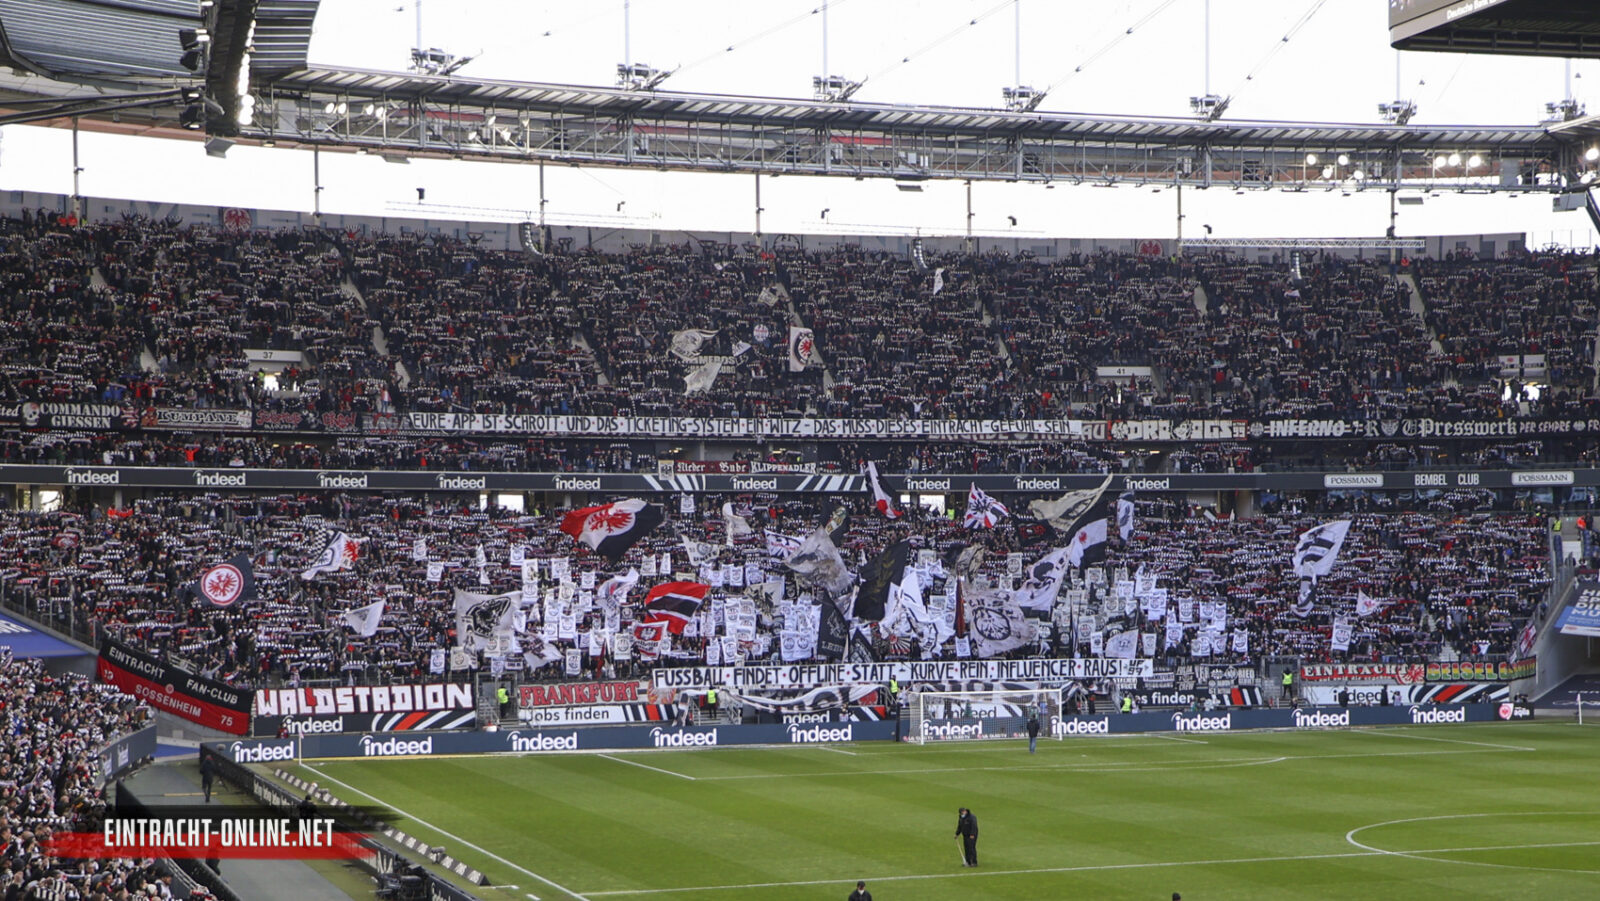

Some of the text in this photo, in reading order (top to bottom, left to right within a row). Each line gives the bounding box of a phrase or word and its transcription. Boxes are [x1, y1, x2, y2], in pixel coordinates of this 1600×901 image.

[263, 351, 273, 359] 37
[1116, 367, 1126, 375] 41
[40, 402, 121, 418] COMMANDO
[157, 409, 238, 425] KUMPANE
[51, 415, 111, 429] GIESSEN
[413, 413, 446, 429] EURE
[453, 413, 476, 429] APP
[482, 414, 499, 429] IST
[505, 414, 560, 429] SCHROTT
[567, 416, 591, 431] UND
[597, 416, 618, 431] DAS
[627, 417, 740, 433] TICKETING-SYSTEM
[746, 418, 763, 433] EIN
[769, 418, 801, 433] WITZ
[814, 419, 836, 433] DAS
[842, 419, 871, 434] MUSS
[876, 419, 916, 434] DIESES
[1270, 419, 1345, 437] INFERNO
[1519, 421, 1536, 433] PER
[1538, 420, 1571, 433] SEMPRE
[65, 467, 119, 484] indeed
[750, 461, 816, 474] KLIPPENADLER
[193, 468, 246, 485] indeed
[316, 470, 368, 487] indeed
[436, 473, 485, 489] indeed
[552, 474, 600, 490] indeed
[730, 475, 777, 490] indeed
[904, 475, 950, 490] indeed
[1014, 475, 1060, 490] indeed
[1124, 475, 1169, 489] indeed
[1330, 476, 1378, 485] POSSMANN
[1414, 473, 1480, 486] BEMBEL CLUB
[1518, 473, 1568, 483] POSSMANN
[108, 646, 239, 705] EINTRACHT FAN-CLUB
[655, 668, 726, 687] FUSSBALL
[733, 667, 782, 684] FINDET
[789, 664, 845, 683] OFFLINE
[852, 664, 895, 681] STATT
[911, 662, 954, 680] KURVE
[997, 659, 1077, 679] INFLUENCER
[1084, 659, 1122, 676] RAUS!
[1304, 663, 1408, 677] EINTRACHT
[256, 683, 473, 716] WALDSTADION
[519, 681, 639, 707] FRANKFURT
[1333, 688, 1383, 702] ideed
[135, 683, 202, 718] SOSSENHEIM
[220, 714, 233, 727] 75
[564, 706, 609, 720] finden
[783, 710, 830, 724] ndeed
[1171, 712, 1231, 731] indeed
[1292, 708, 1349, 727] indeed
[1409, 705, 1465, 724] indeed
[284, 715, 343, 734] indeed
[787, 723, 852, 743] indeed
[922, 719, 982, 736] indeed
[1051, 716, 1108, 734] indeed
[359, 735, 433, 756] indeed
[507, 730, 578, 751] indeed
[649, 727, 717, 747] indeed
[230, 740, 294, 763] indeed
